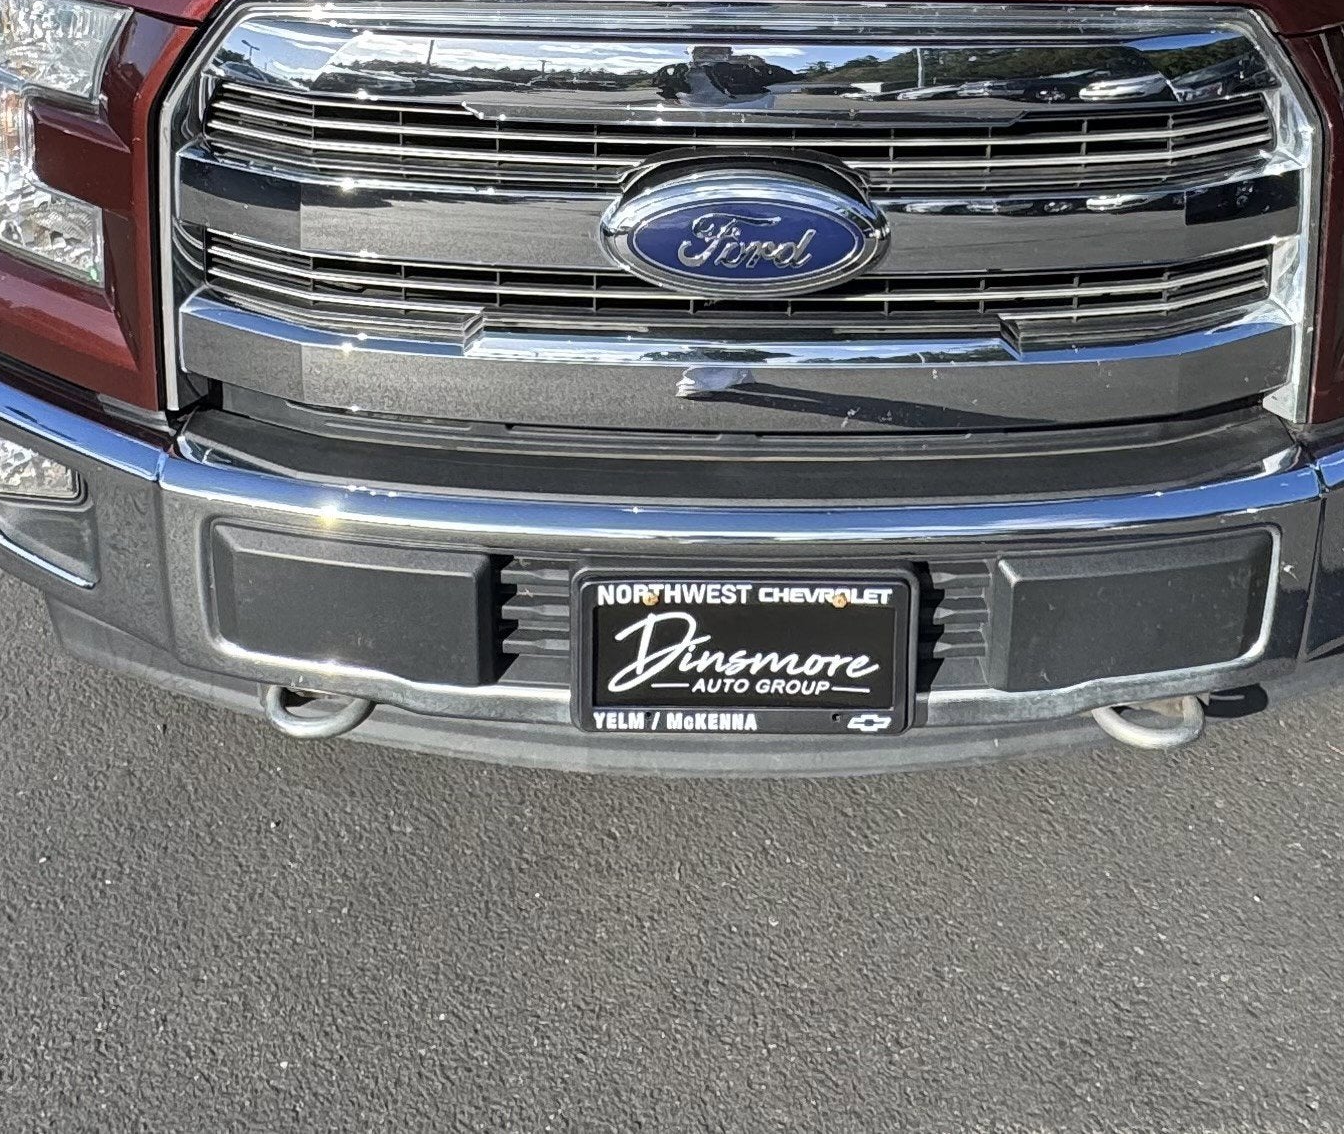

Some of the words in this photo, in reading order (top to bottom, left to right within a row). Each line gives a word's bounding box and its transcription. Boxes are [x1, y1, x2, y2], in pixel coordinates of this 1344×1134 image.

[677, 212, 817, 269] Ford
[597, 583, 753, 606] NORTHWEST
[758, 587, 893, 605] CHEVROLET
[607, 611, 880, 693] Dinsmore
[692, 678, 749, 694] AUTO
[755, 679, 831, 696] GROUP
[593, 712, 646, 730] YELM
[666, 712, 758, 731] McKENNA
